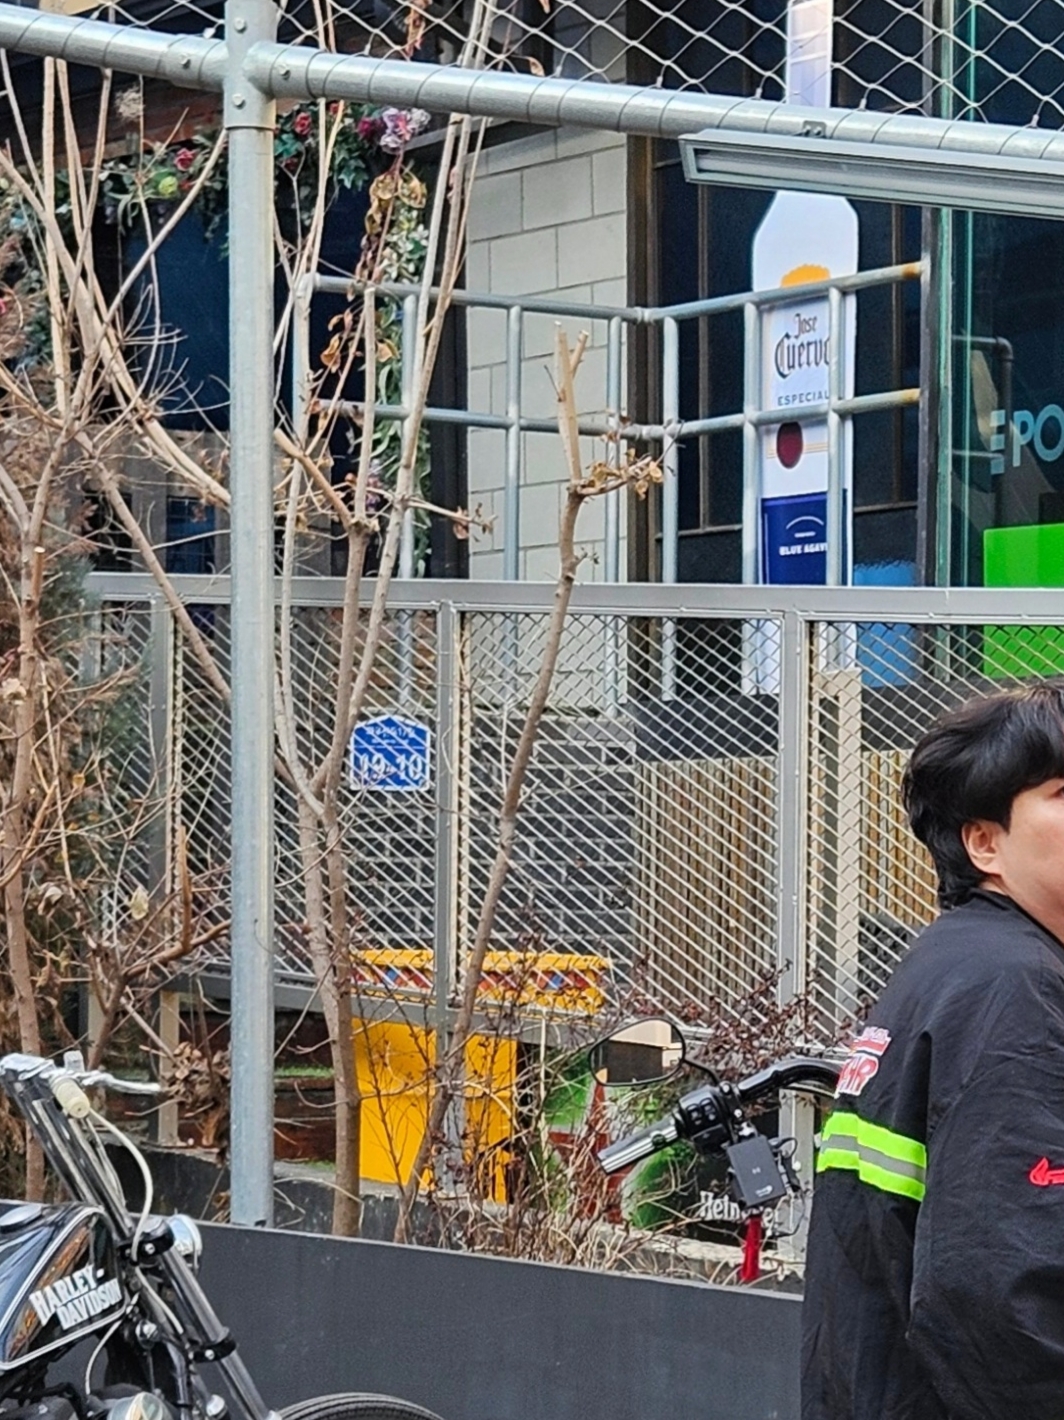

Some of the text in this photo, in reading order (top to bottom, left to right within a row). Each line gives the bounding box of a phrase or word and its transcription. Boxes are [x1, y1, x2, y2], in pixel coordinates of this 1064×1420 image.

[777, 389, 830, 407] ESPECIAL
[803, 541, 828, 554] AGAV
[56, 1277, 123, 1331] DAVIDSON
